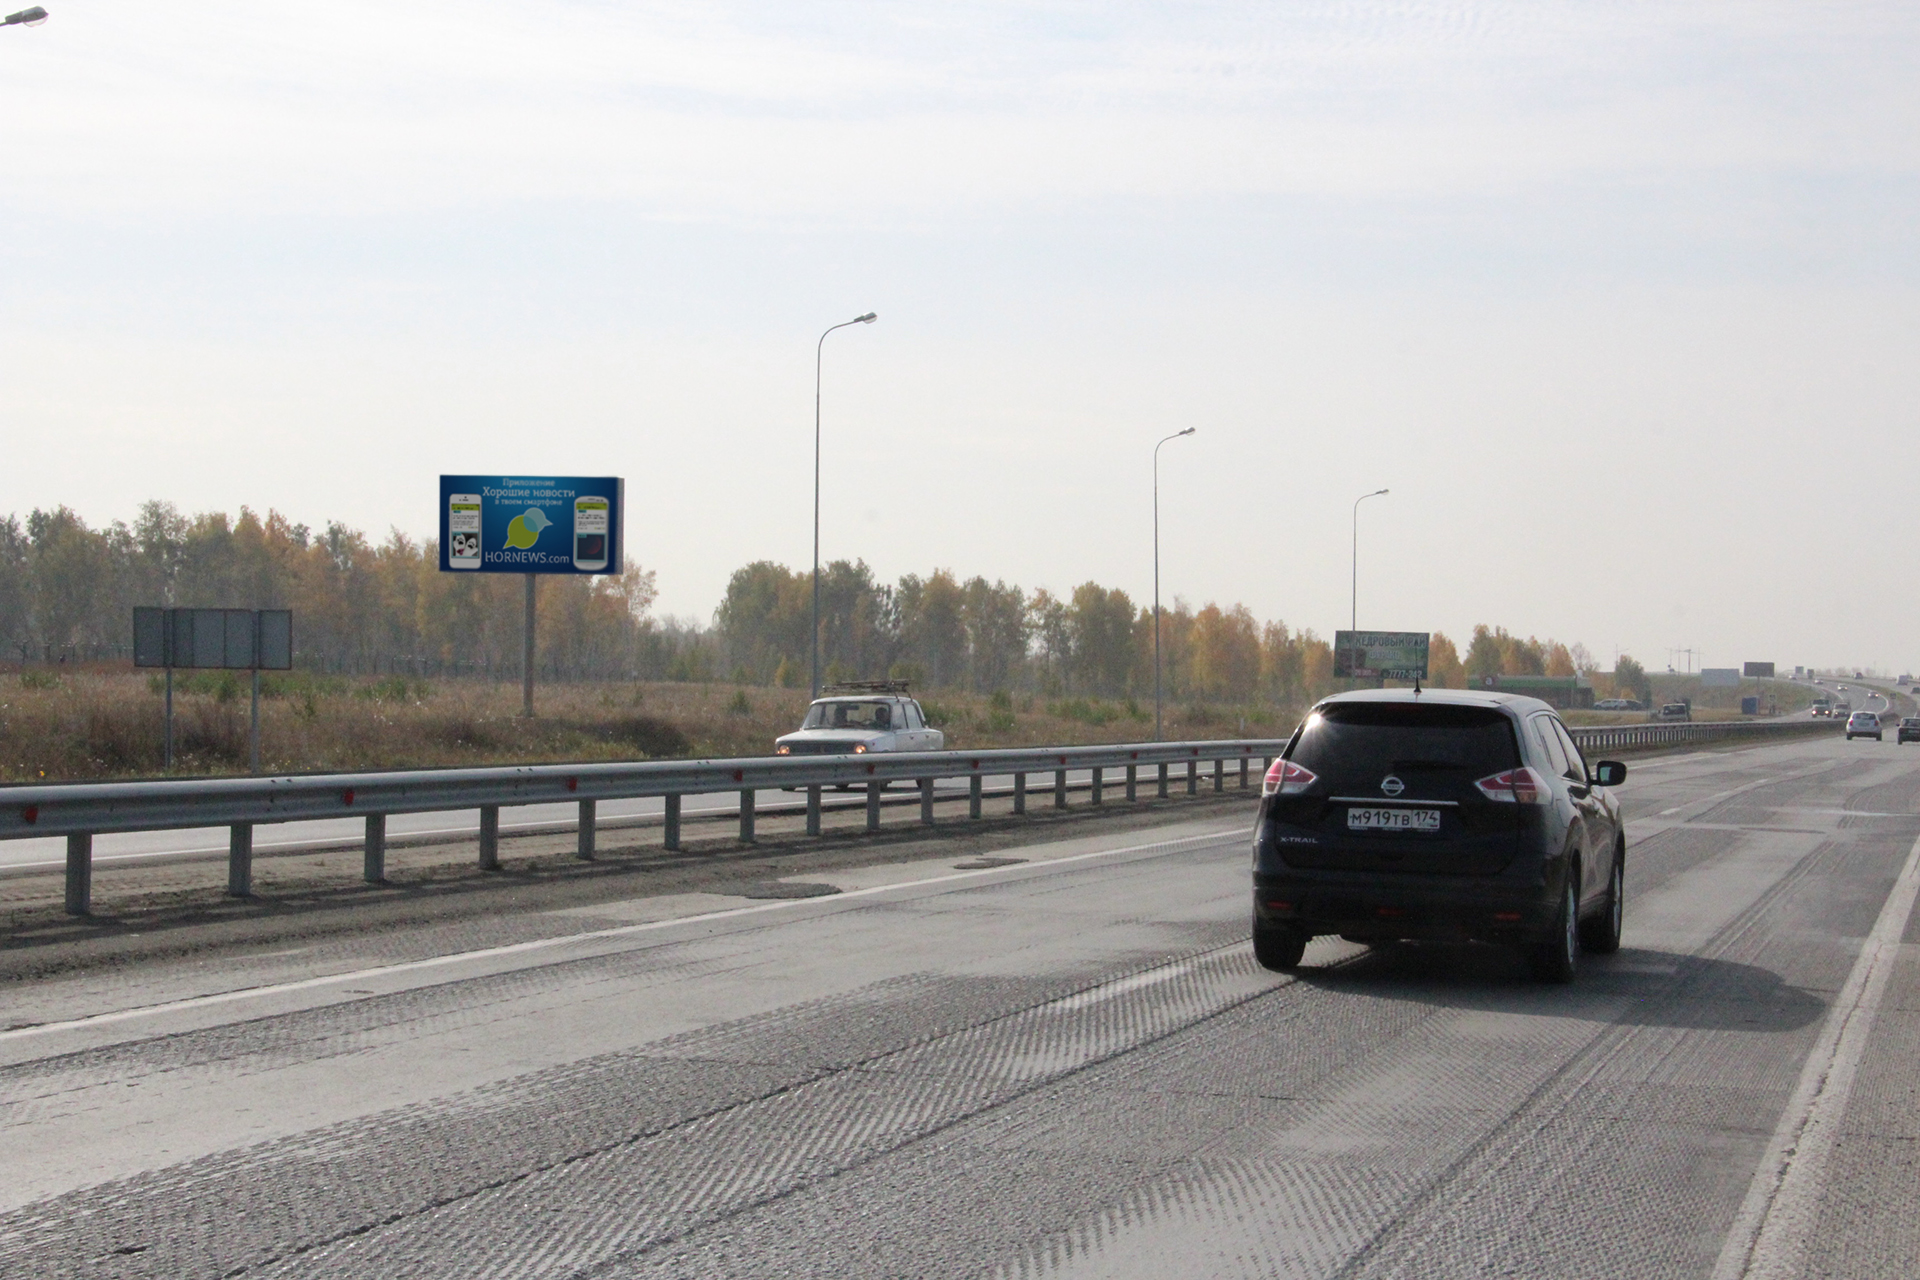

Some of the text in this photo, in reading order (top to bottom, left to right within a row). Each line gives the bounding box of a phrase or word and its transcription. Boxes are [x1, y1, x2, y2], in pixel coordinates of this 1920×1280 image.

[502, 478, 556, 487] Приложение
[482, 486, 576, 498] Хорошие новости
[524, 498, 563, 507] смартфоне
[485, 551, 570, 564] HORNEWS.com
[1414, 811, 1438, 823] 174
[1280, 836, 1318, 844] X-TRAIL
